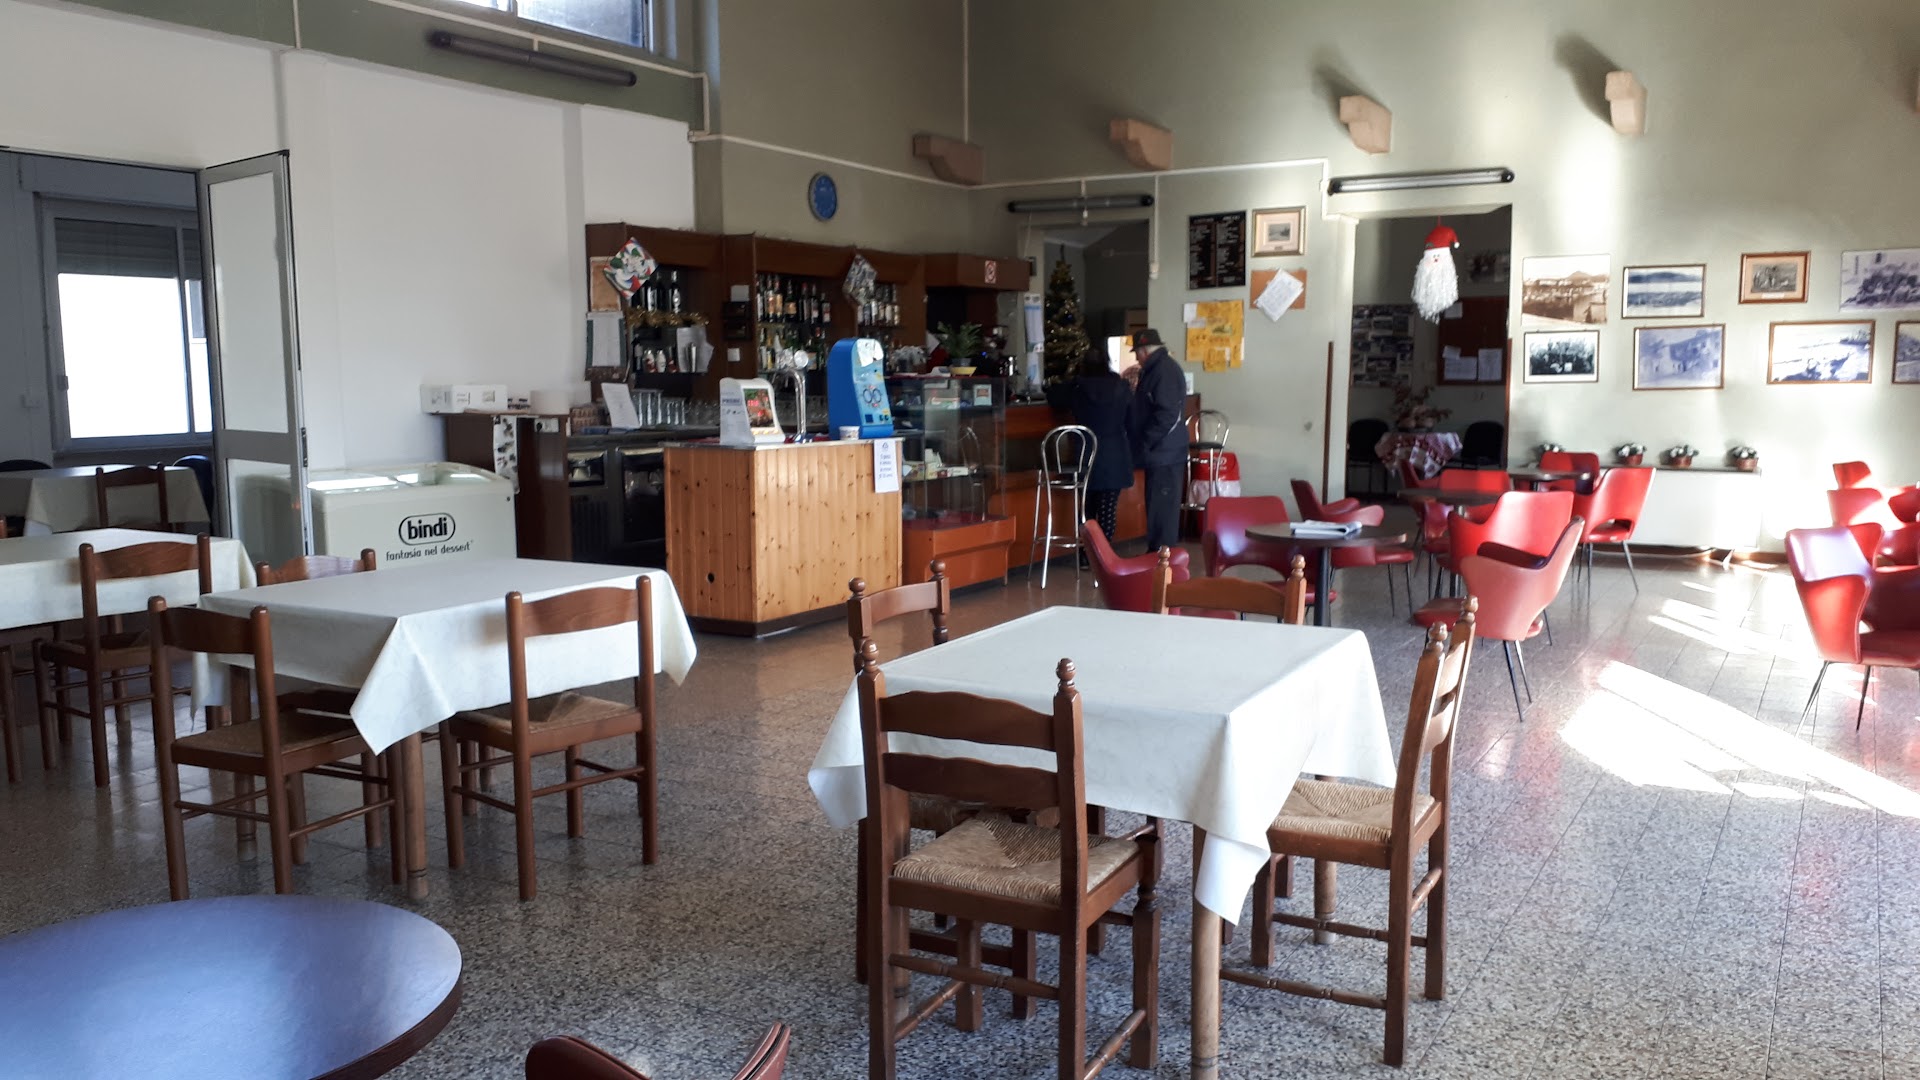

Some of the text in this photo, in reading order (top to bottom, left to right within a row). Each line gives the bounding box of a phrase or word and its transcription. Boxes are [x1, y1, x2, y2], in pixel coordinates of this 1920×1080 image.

[407, 517, 448, 540] bindi
[386, 541, 470, 561] fantasia nel dessert
